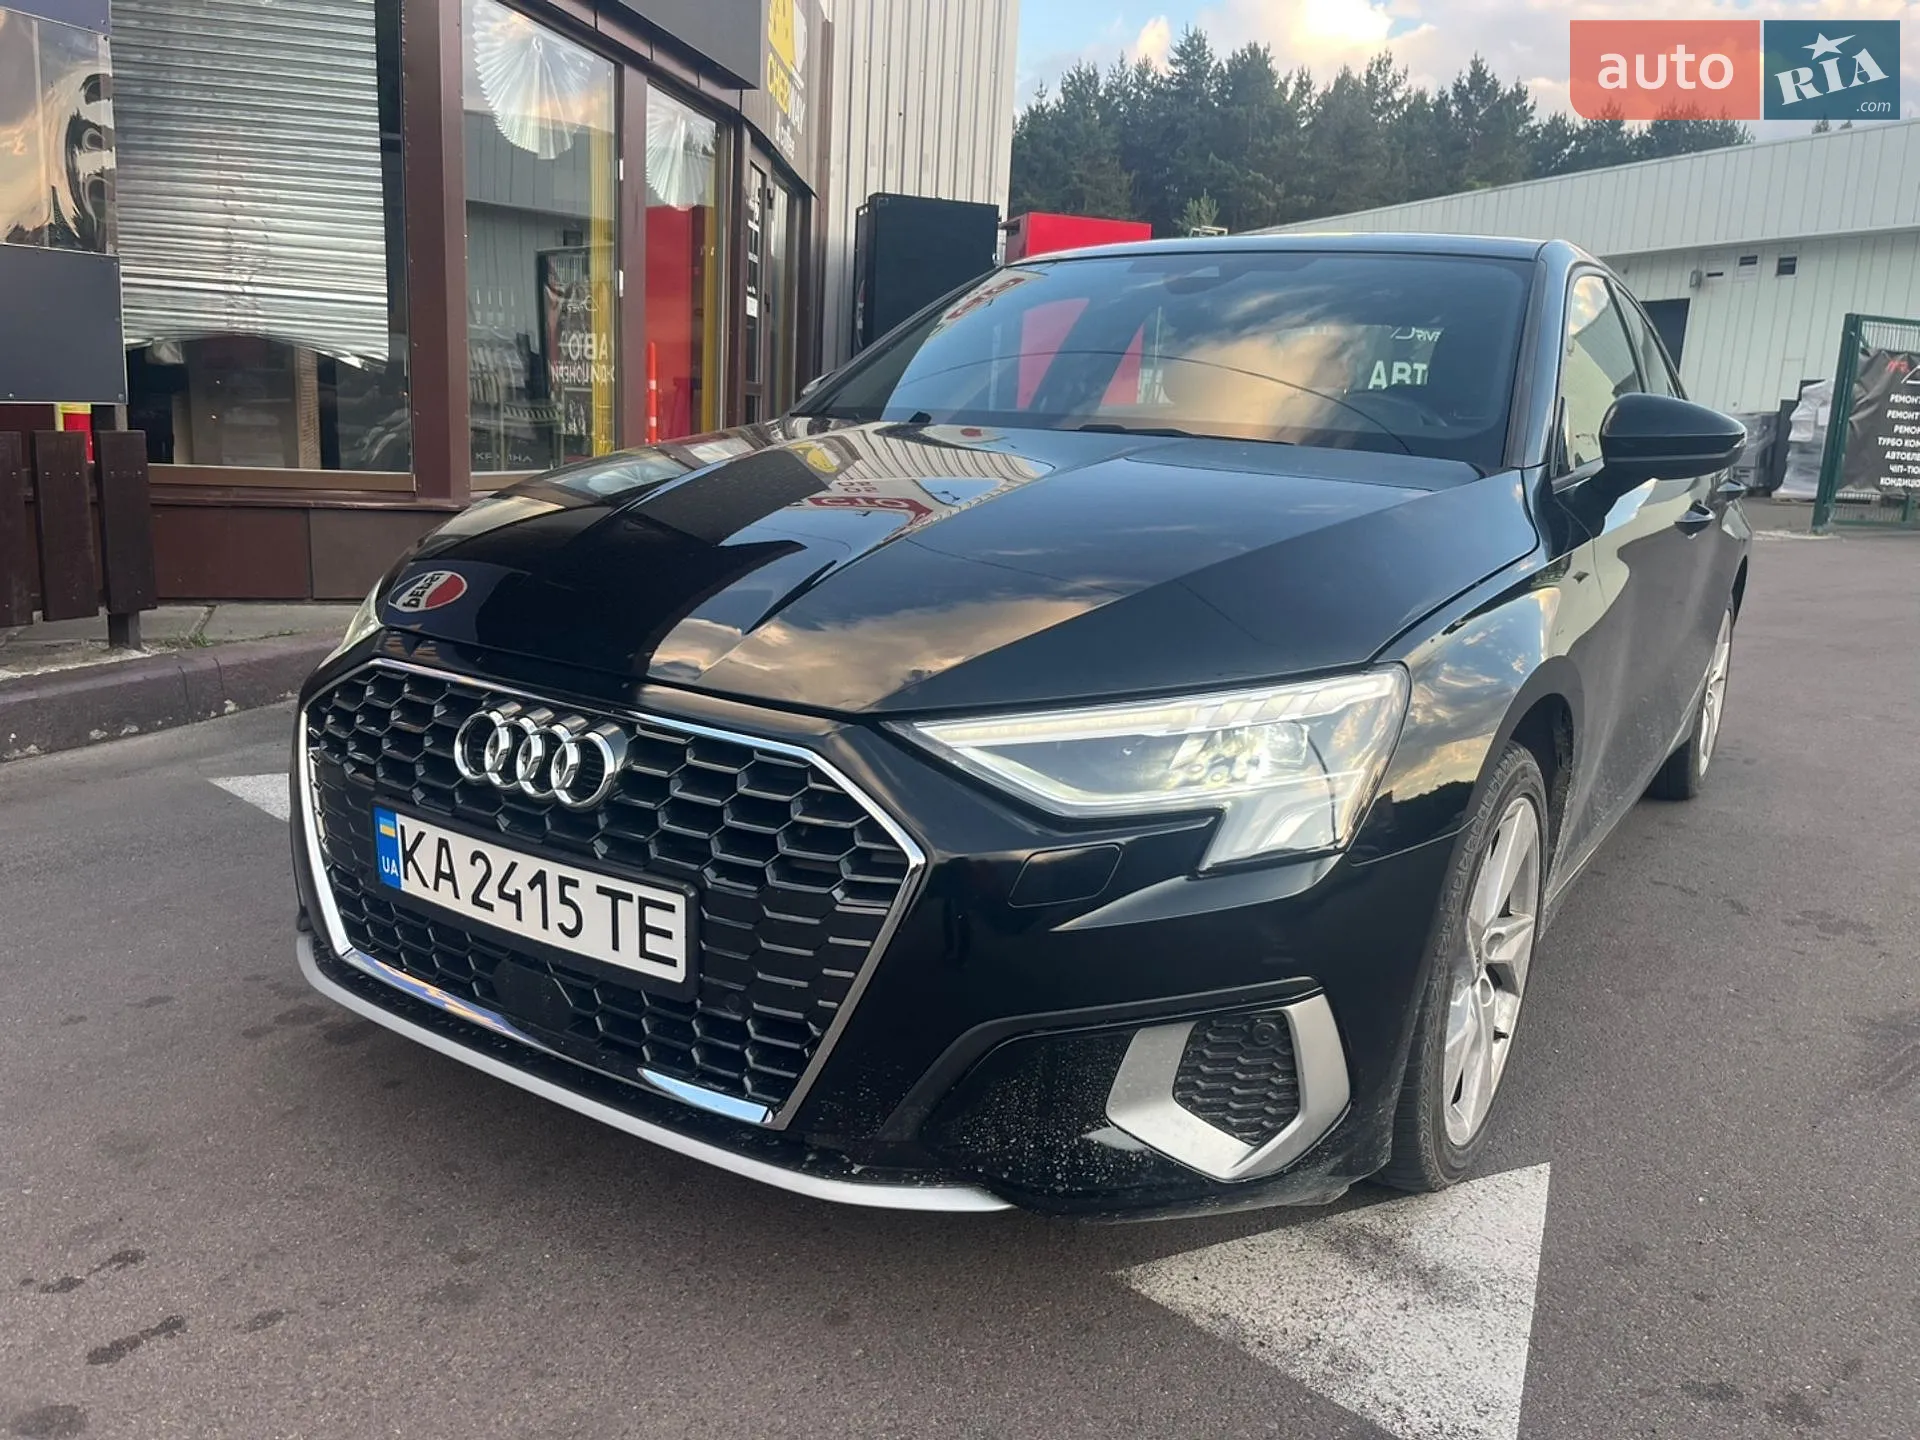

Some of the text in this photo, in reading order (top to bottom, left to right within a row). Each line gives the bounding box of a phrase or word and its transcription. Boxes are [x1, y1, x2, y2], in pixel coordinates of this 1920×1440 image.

[381, 856, 399, 877] UA
[400, 823, 678, 968] KA 2415 TE
